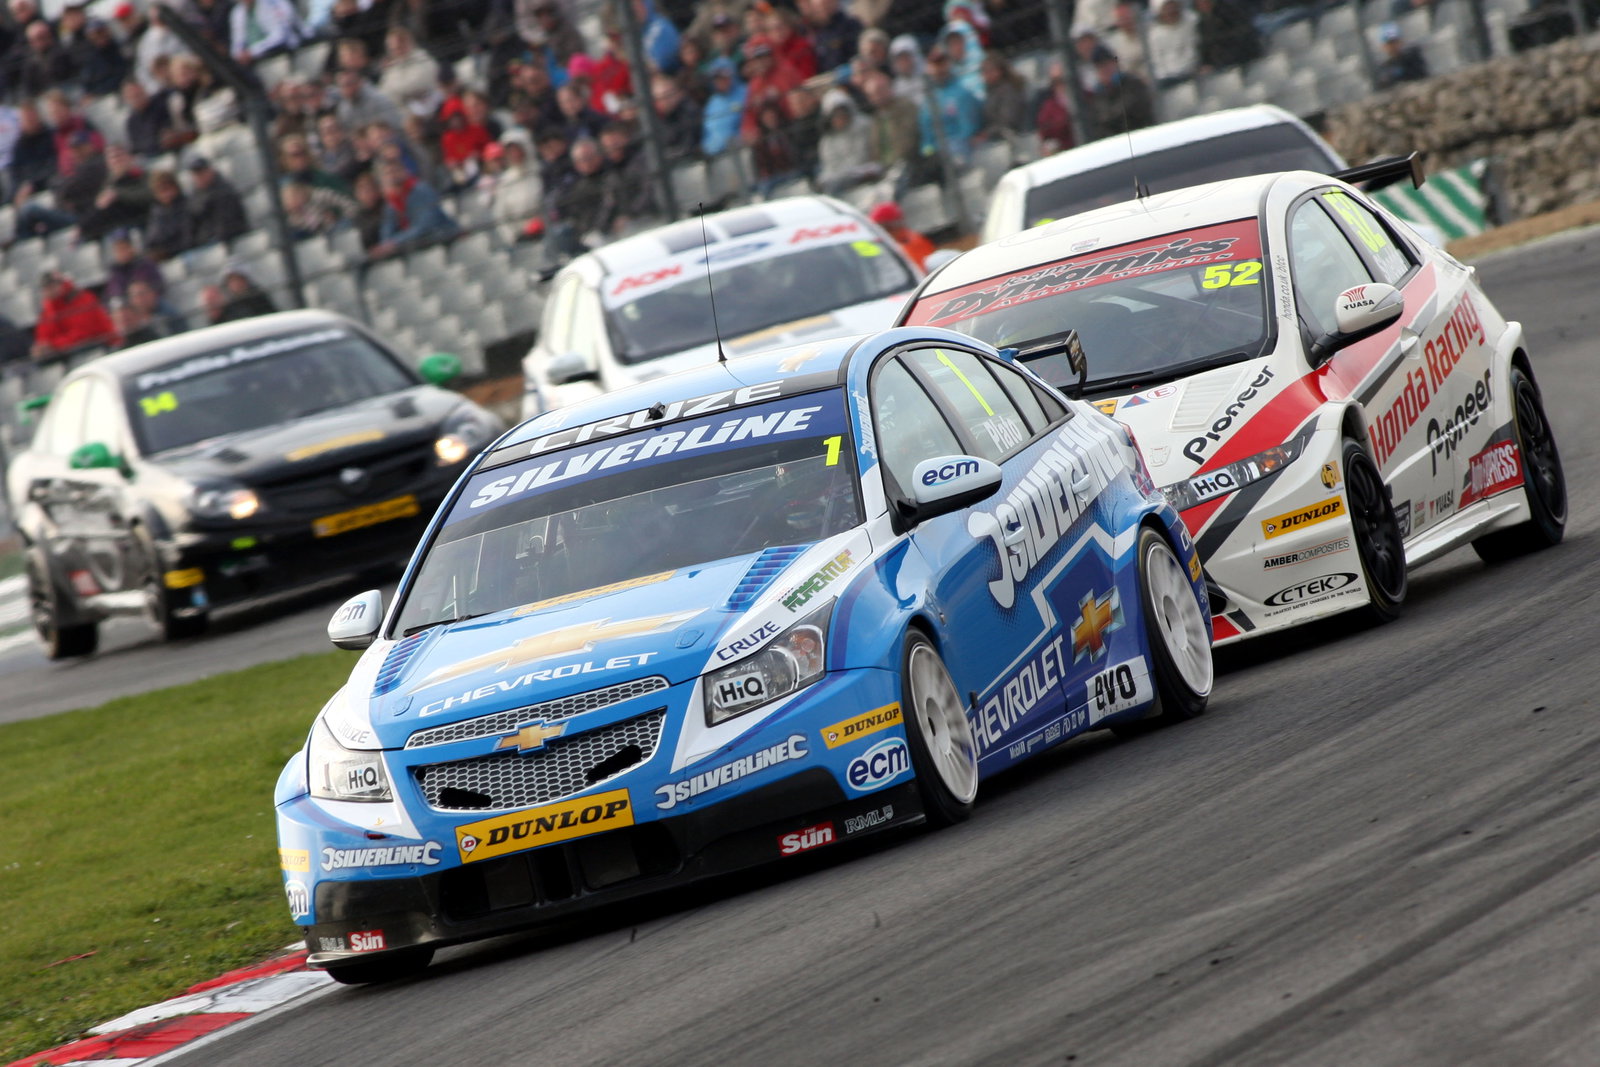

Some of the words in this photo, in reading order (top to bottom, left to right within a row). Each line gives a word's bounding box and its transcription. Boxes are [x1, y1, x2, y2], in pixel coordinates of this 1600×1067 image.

[1201, 261, 1263, 290] 52
[1343, 298, 1376, 311] YUASA
[935, 349, 995, 417] 1
[1368, 366, 1431, 472] Honda
[1424, 290, 1487, 394] Racing
[529, 379, 785, 456] CRUZE
[1182, 365, 1276, 466] Pioneer
[1426, 368, 1493, 478] Pioneer
[982, 415, 1024, 454] Plato
[822, 435, 843, 467] 1
[922, 460, 980, 487] ecm
[1193, 471, 1235, 497] HiQ
[1280, 501, 1341, 529] DUNLOP
[1280, 576, 1334, 603] CTEK
[716, 620, 782, 662] CRUZE
[418, 651, 659, 718] CHEVROLET
[719, 675, 764, 705] HiQ
[968, 634, 1066, 758] HEVROLET
[843, 708, 900, 737] DUNLOP
[348, 766, 378, 790] HiQ
[849, 743, 909, 787] ecm
[486, 799, 628, 847] DUNLOP
[781, 826, 833, 854] Sun
[350, 933, 384, 951] Sun
